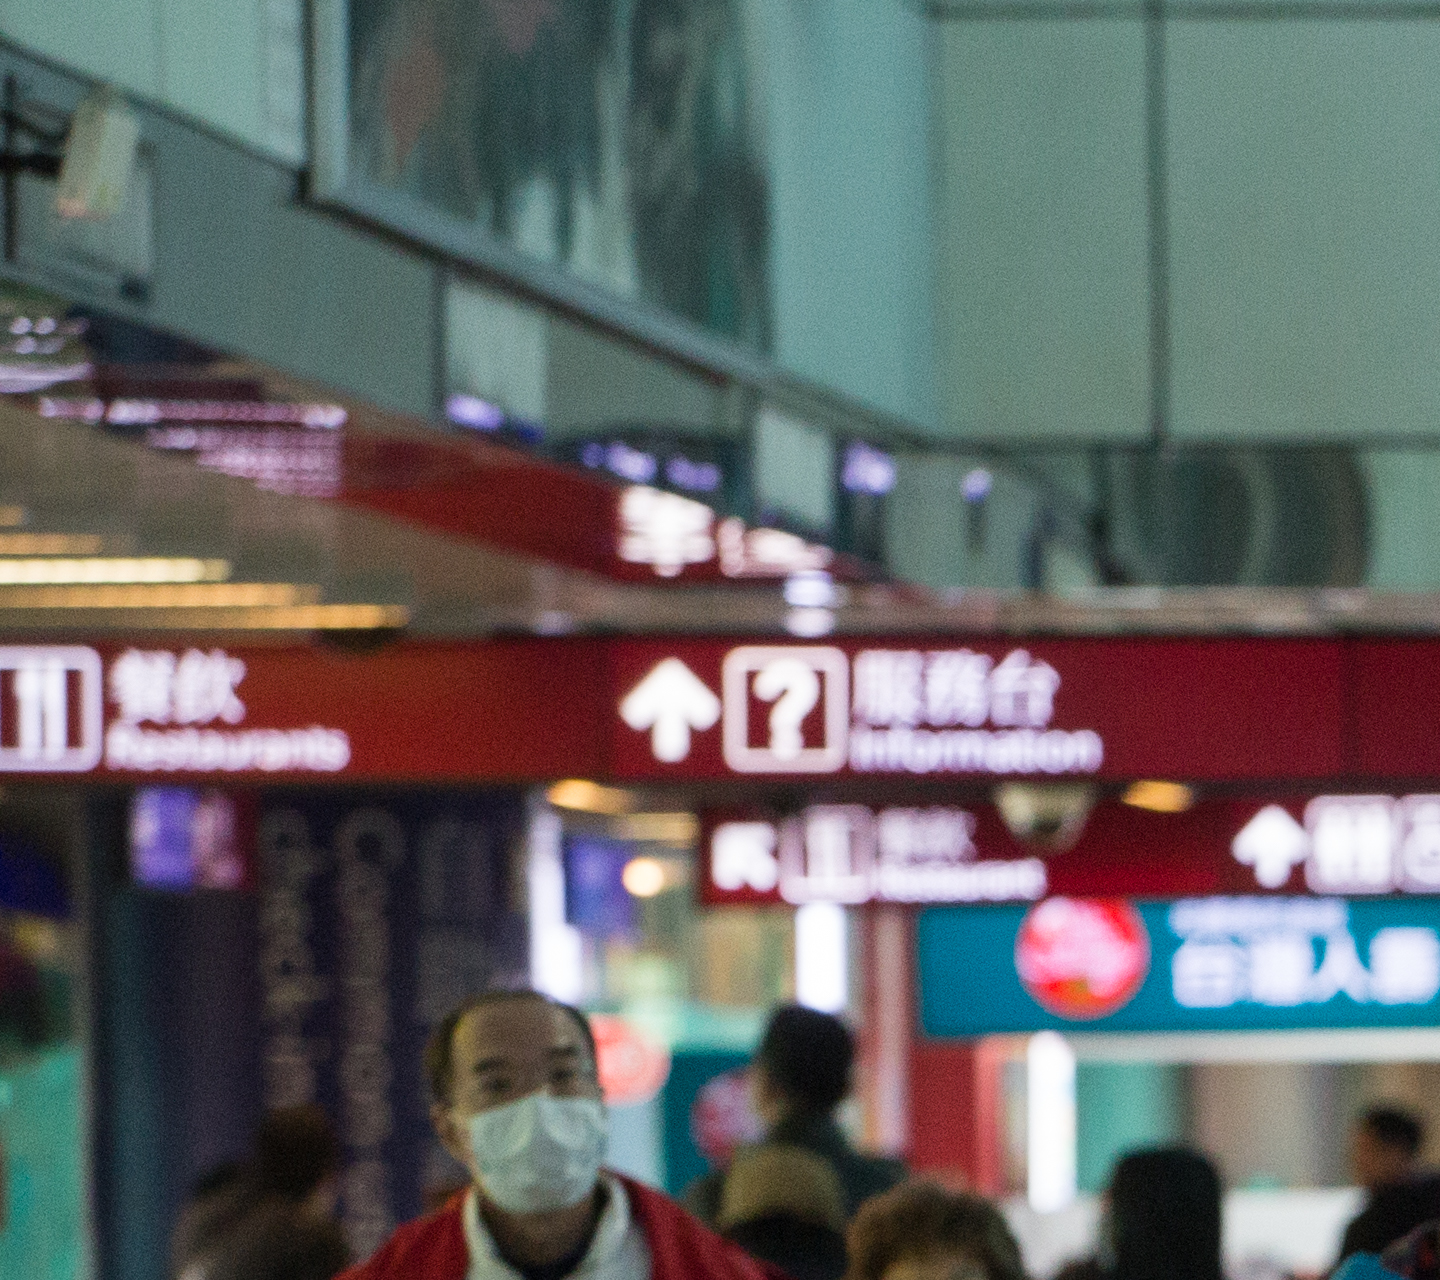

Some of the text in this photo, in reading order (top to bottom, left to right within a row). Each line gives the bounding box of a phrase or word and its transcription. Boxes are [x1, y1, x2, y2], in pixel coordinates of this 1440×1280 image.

[109, 647, 249, 727] 餐飲
[851, 647, 1062, 729] 服務台
[105, 725, 351, 772] Restaurants
[850, 728, 1104, 775] Information
